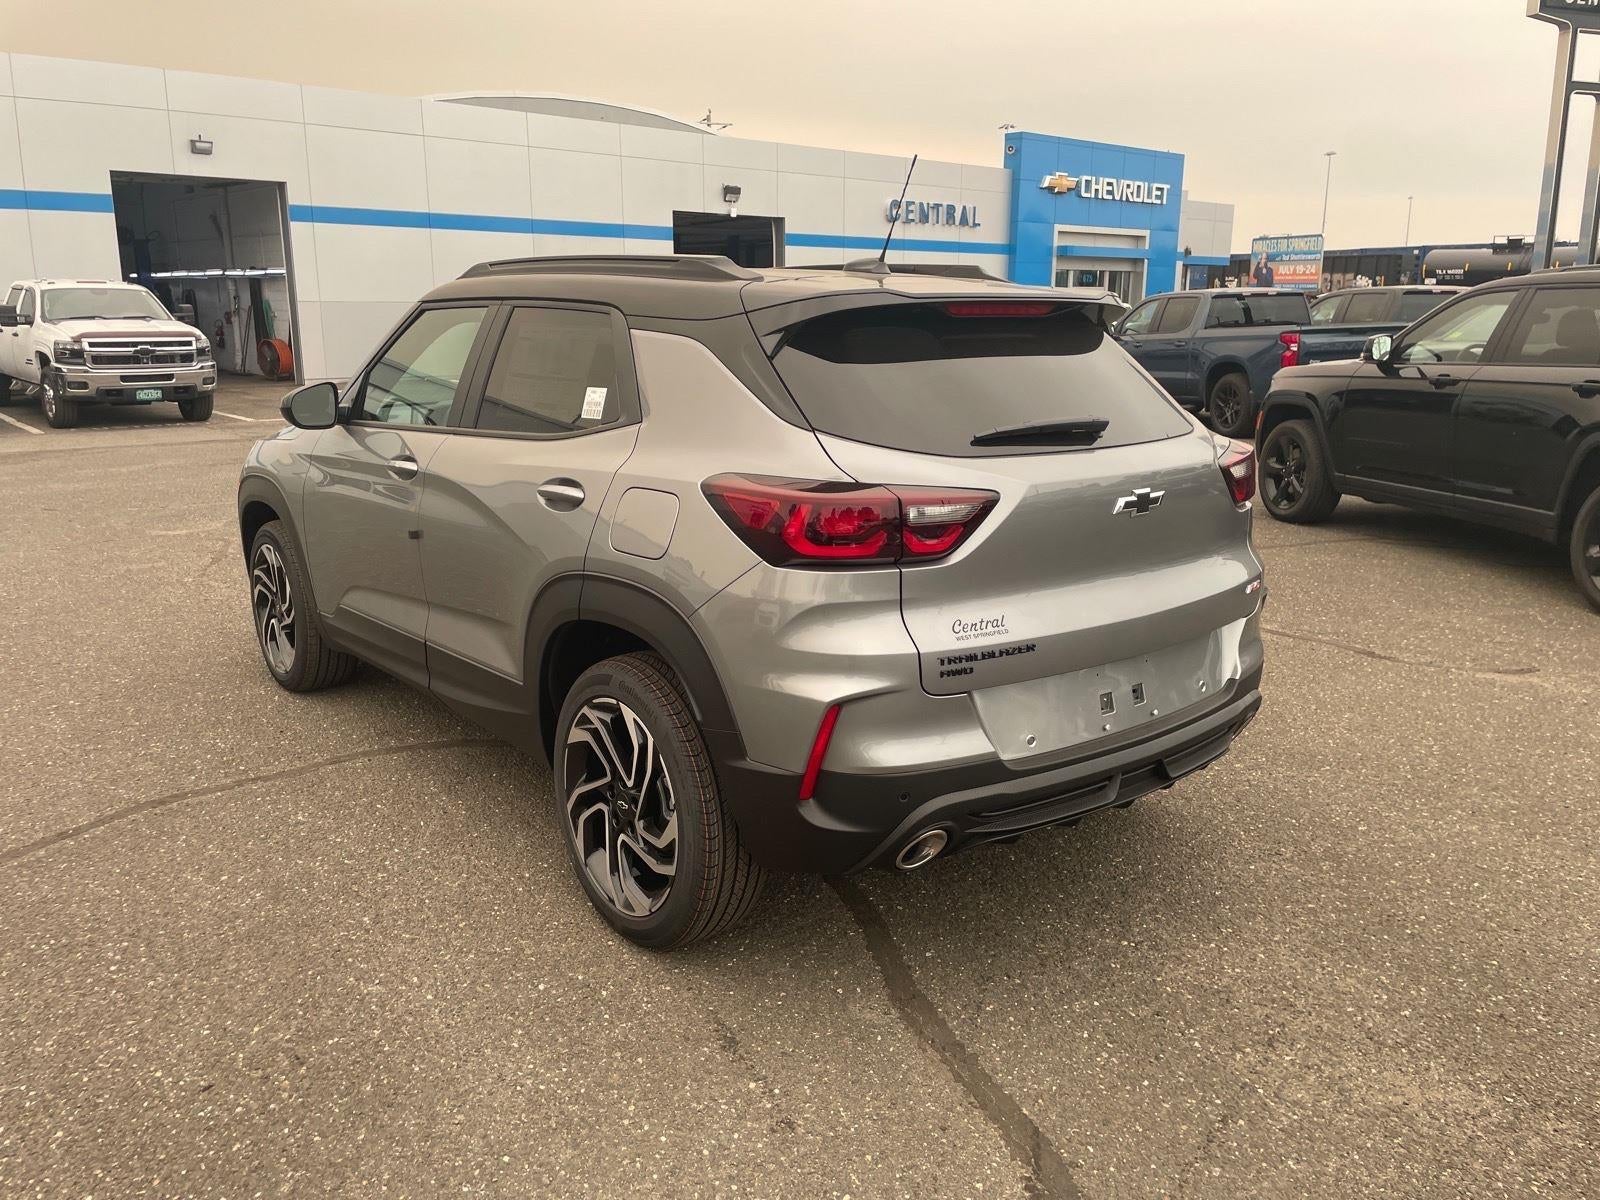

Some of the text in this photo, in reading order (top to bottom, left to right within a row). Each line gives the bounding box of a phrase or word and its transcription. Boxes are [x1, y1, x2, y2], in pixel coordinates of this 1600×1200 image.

[1079, 175, 1169, 206] CHEVROLET
[886, 199, 981, 227] CENTRAL
[1278, 265, 1294, 274] JULY
[952, 614, 1006, 634] Central
[955, 628, 1009, 642] WEST SPRINGFIELD
[937, 643, 1037, 666] TRAILBLAZER
